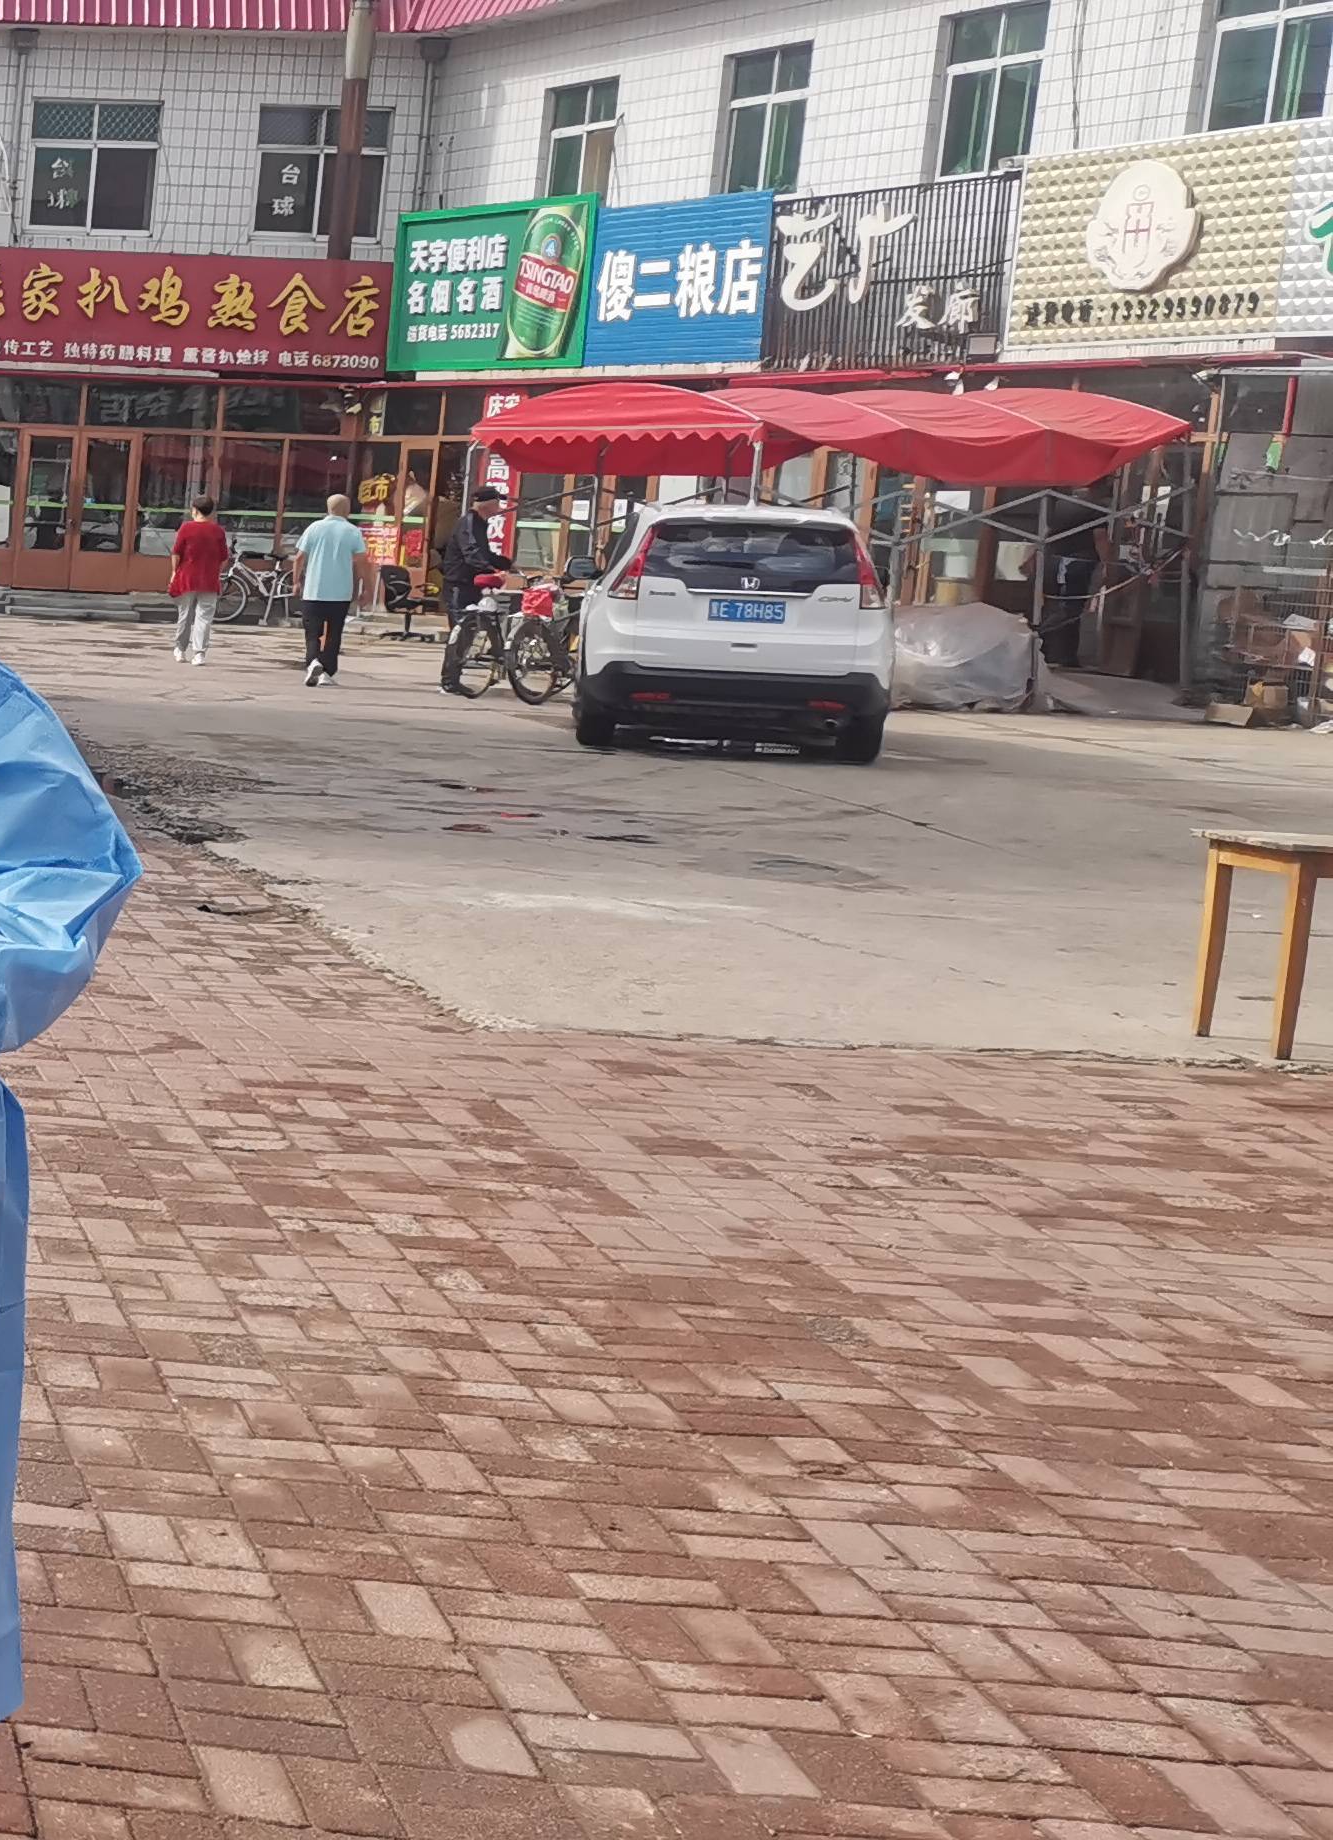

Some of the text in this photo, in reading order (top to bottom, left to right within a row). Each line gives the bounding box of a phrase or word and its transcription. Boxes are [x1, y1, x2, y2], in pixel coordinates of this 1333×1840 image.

[409, 234, 507, 273] 天宇便利店
[407, 276, 503, 315] 名烟名酒
[520, 258, 574, 294] TSINGTAO
[597, 238, 765, 322] 傻二粮店
